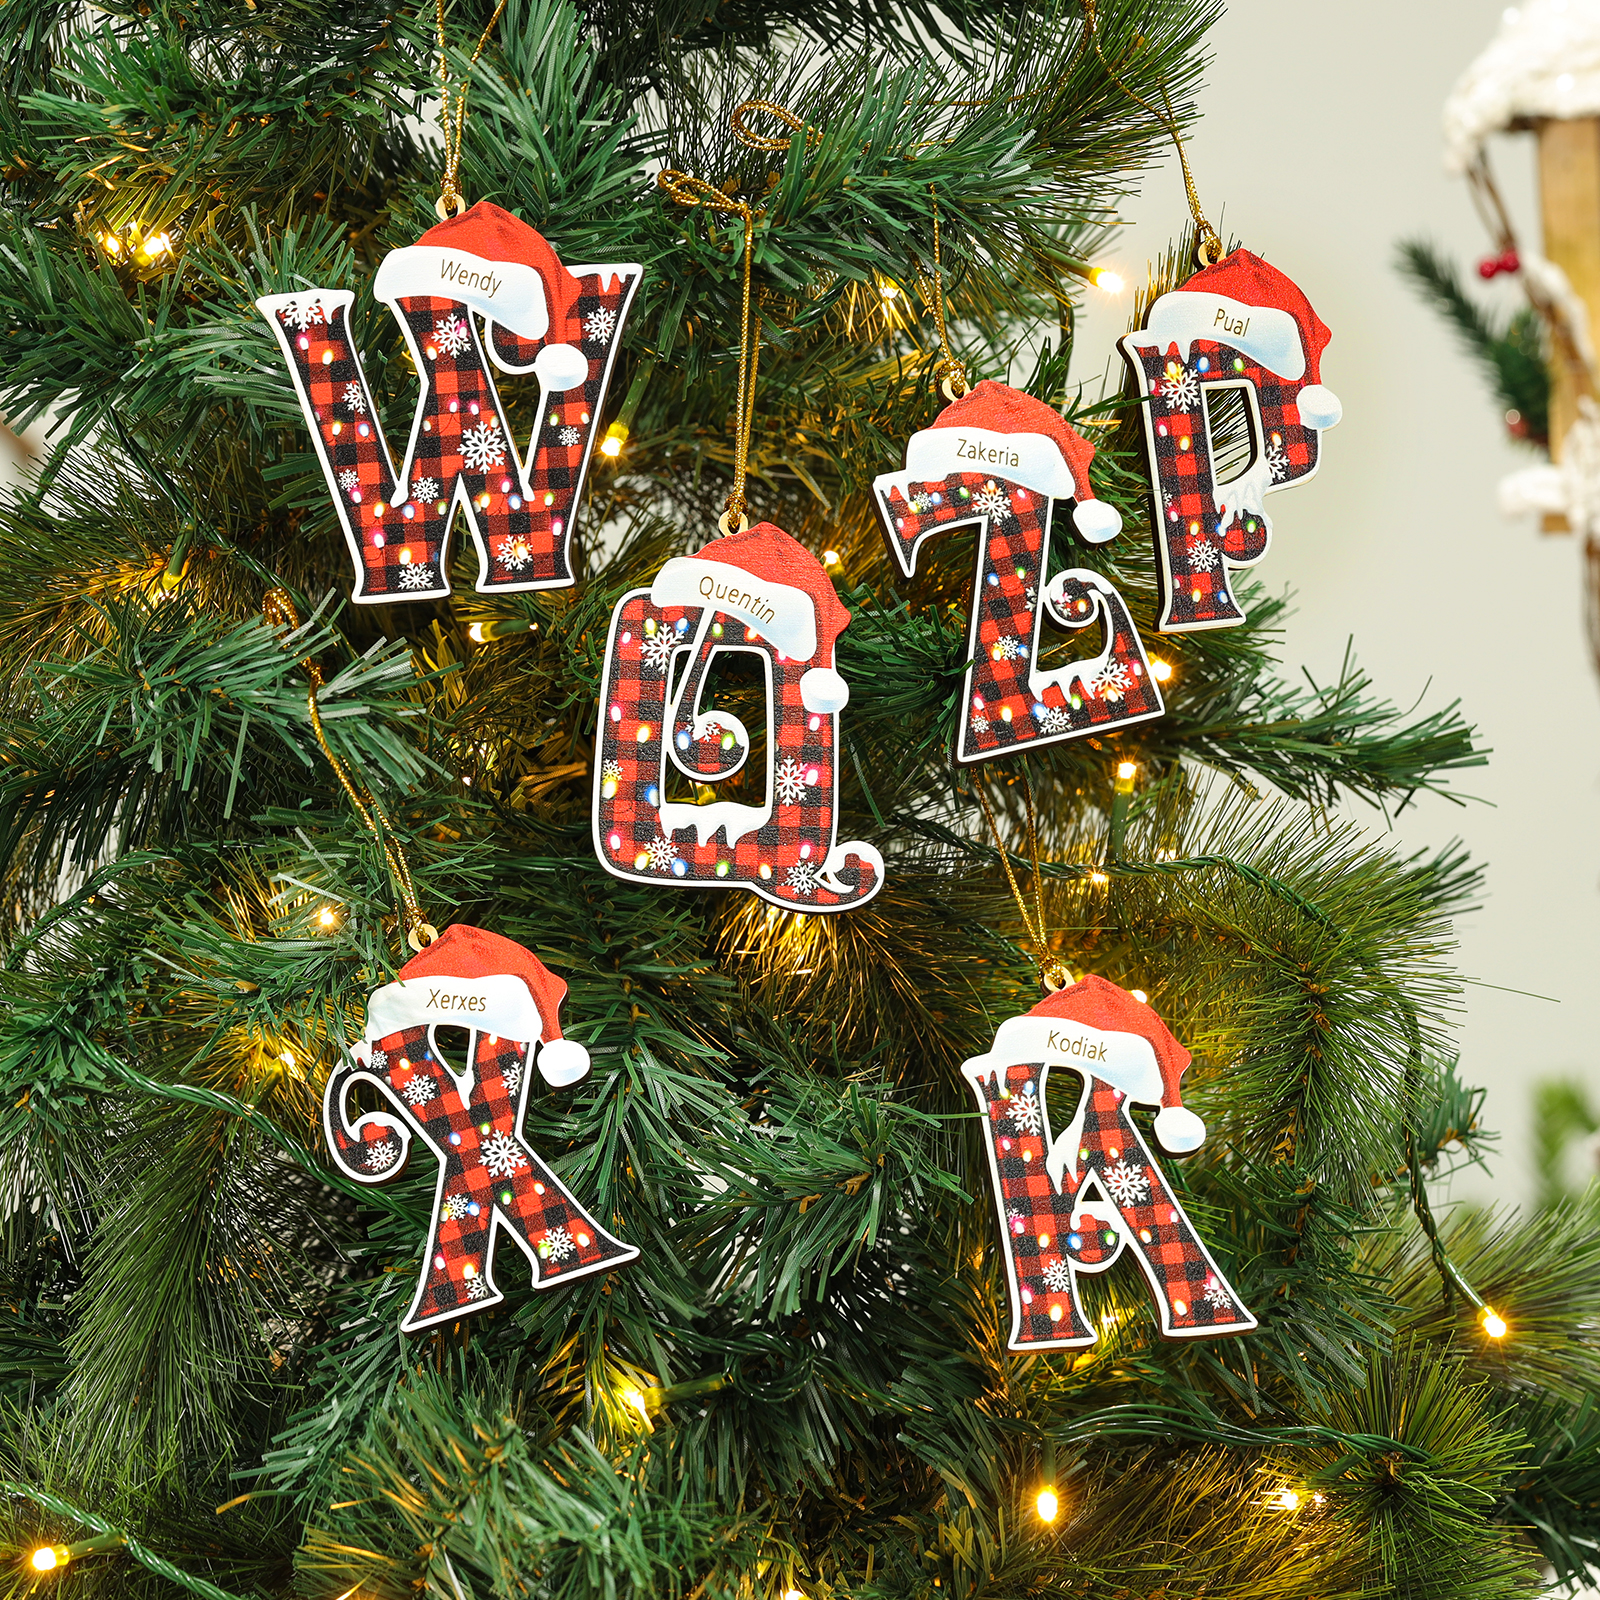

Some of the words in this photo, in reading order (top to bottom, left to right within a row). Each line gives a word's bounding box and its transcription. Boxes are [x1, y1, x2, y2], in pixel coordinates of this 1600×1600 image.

[440, 259, 502, 298] Wendy
[1213, 308, 1250, 337] Pual
[956, 438, 1019, 467] Zakeria
[699, 576, 775, 624] Quentin
[426, 988, 487, 1011] Xerxes
[1047, 1030, 1108, 1062] Kodiak
